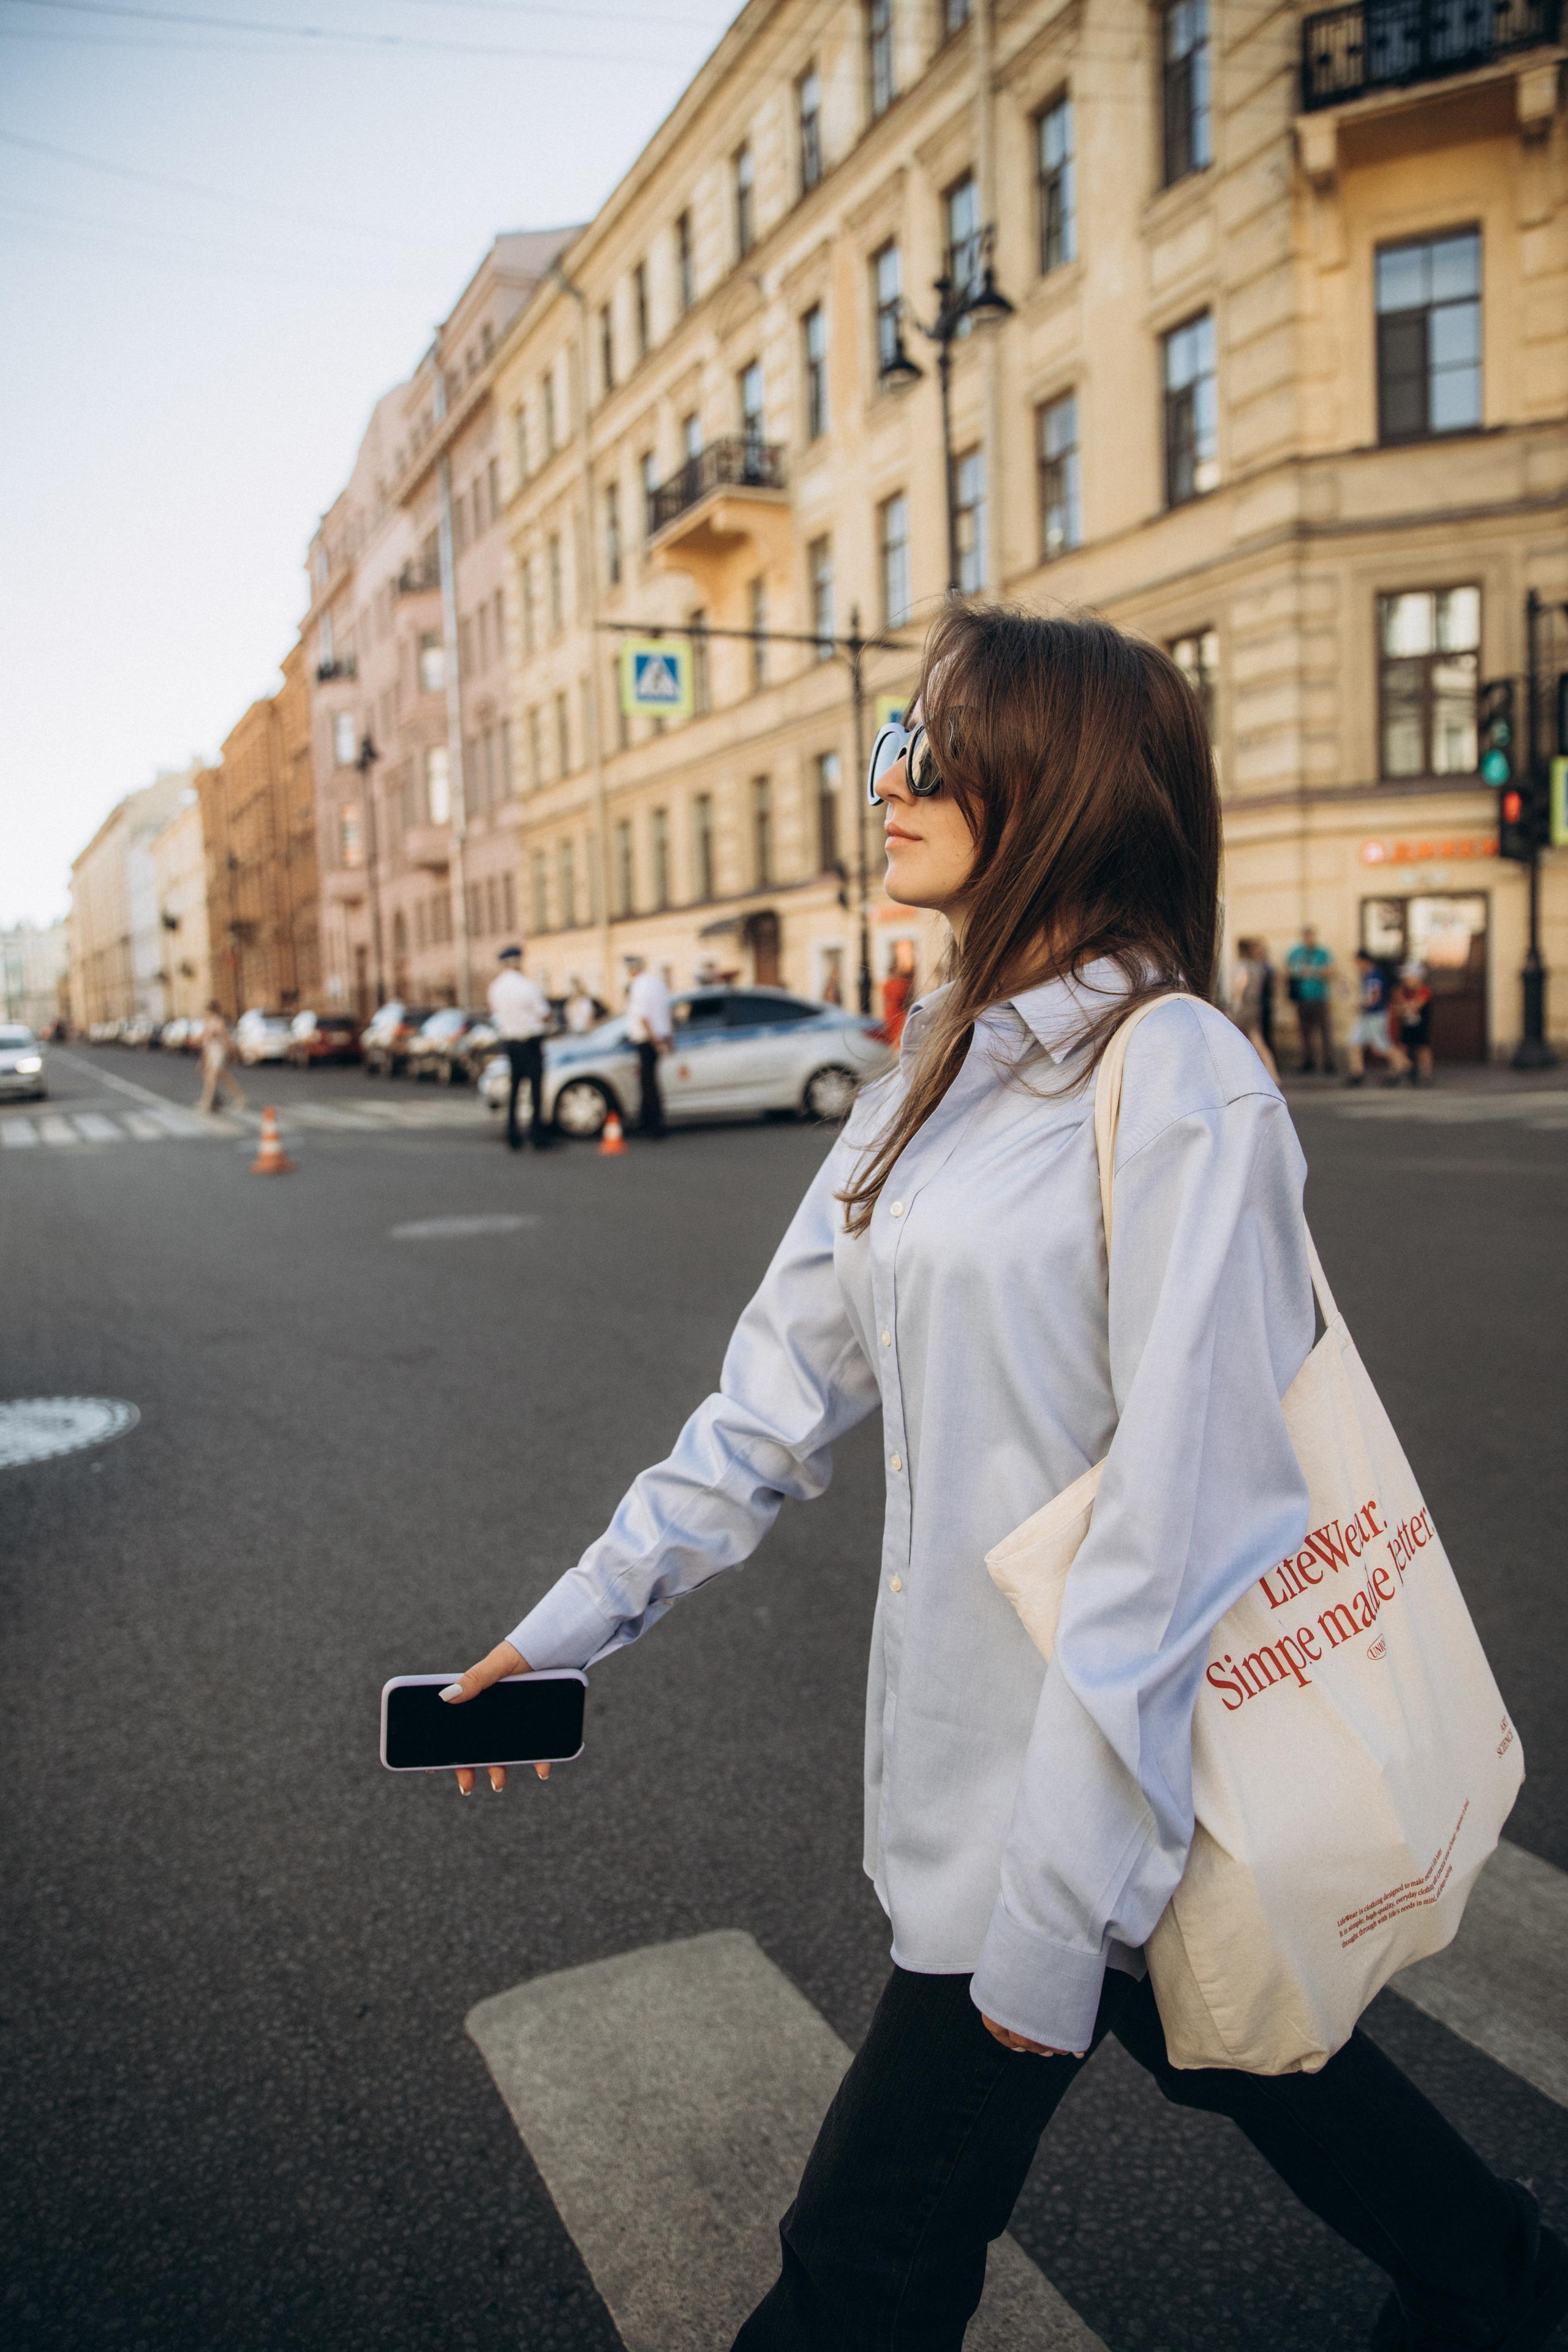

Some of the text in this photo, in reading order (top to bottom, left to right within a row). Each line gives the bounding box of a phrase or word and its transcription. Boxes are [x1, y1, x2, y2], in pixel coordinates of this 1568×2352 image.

[1206, 1627, 1322, 1711] Simpe
[1337, 1911, 1358, 1927] LifeWear
[1363, 1898, 1383, 1912] clothing
[1384, 1883, 1404, 1901] designed
[1411, 1877, 1425, 1887] make
[1396, 1891, 1417, 1905] everyday
[1341, 1932, 1359, 1948] thought
[1359, 1921, 1377, 1936] through
[1378, 1915, 1388, 1924] with
[1389, 1909, 1400, 1918] life's
[1401, 1902, 1415, 1912] needs
